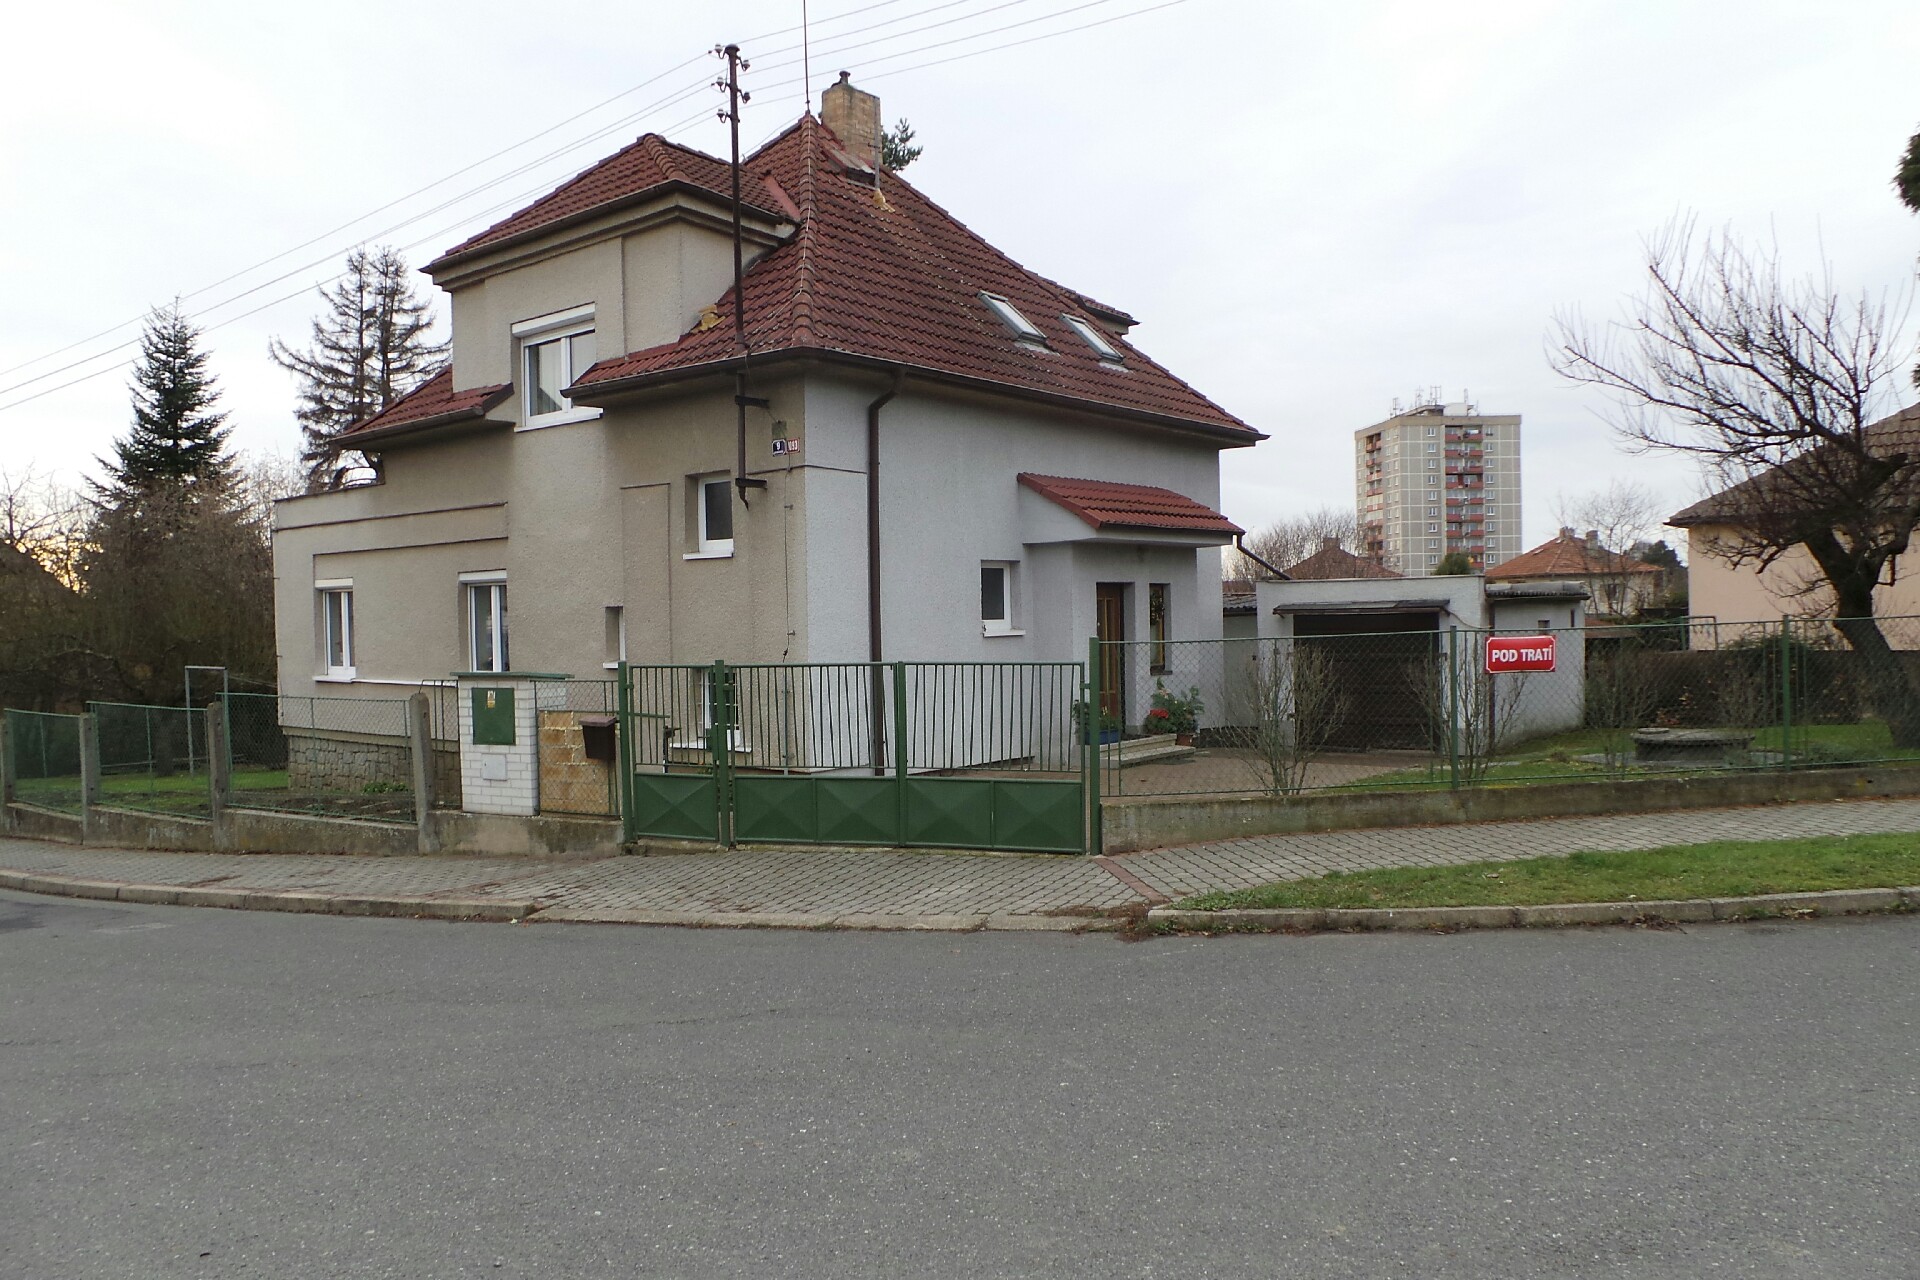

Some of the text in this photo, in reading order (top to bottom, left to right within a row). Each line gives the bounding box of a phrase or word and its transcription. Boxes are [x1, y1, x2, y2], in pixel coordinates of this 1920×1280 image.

[776, 441, 781, 450] 9
[1492, 645, 1553, 662] POD TRATÍ
